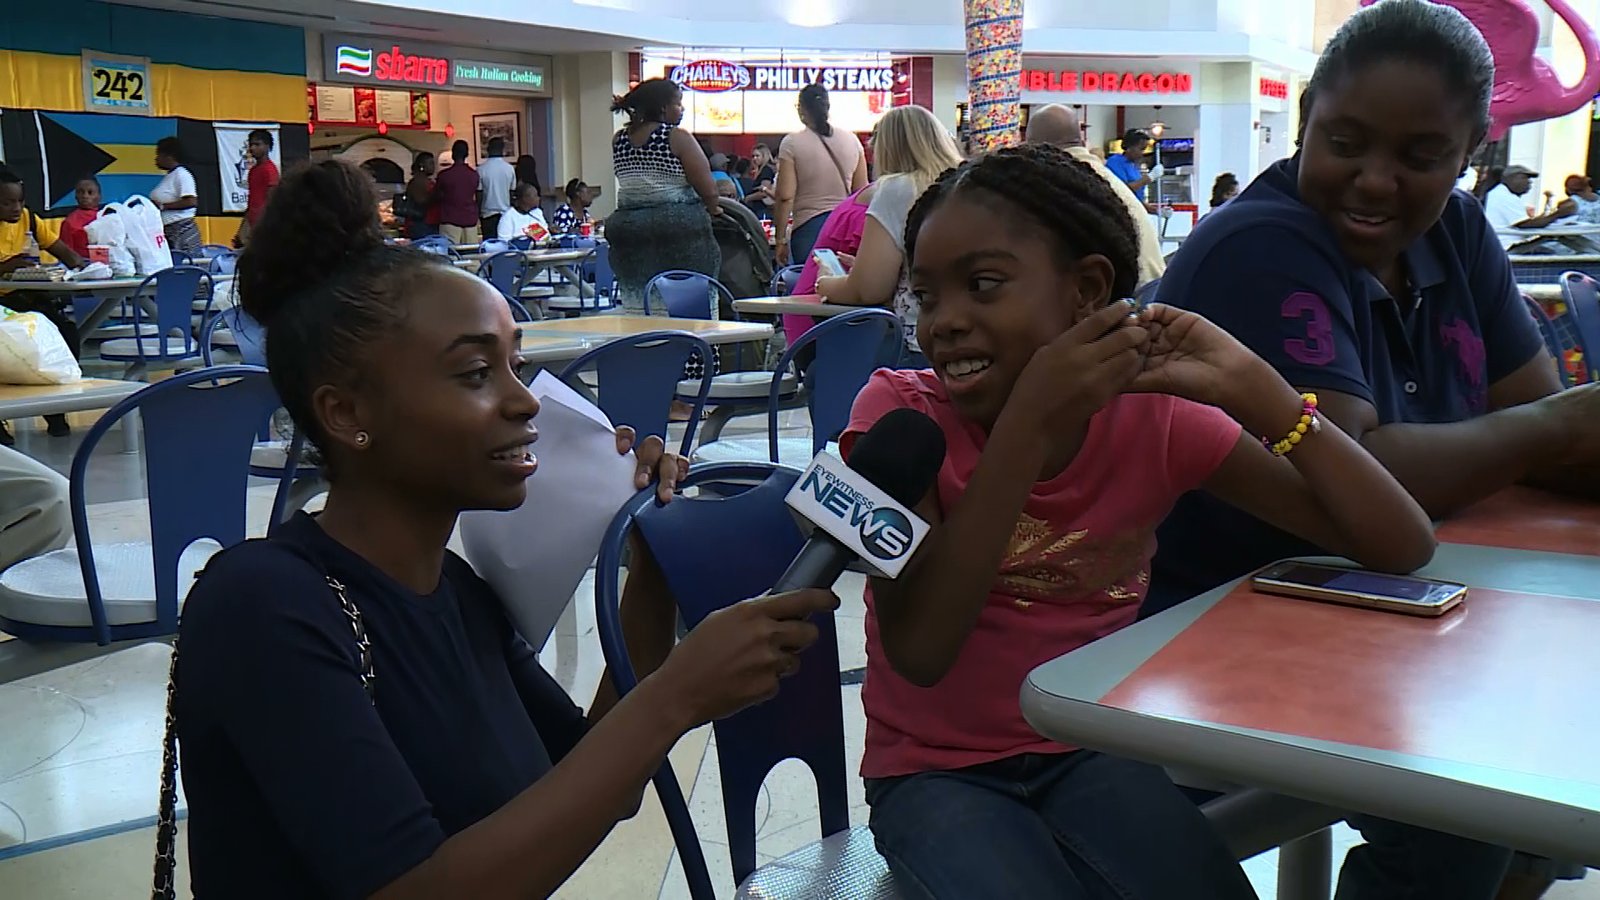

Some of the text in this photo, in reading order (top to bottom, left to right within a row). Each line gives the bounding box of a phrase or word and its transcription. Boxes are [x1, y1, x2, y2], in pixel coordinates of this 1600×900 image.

[374, 44, 449, 86] sbarro
[455, 65, 479, 79] Fresh
[510, 70, 542, 86] Cooking
[671, 65, 750, 87] CHARLEYS
[755, 68, 894, 90] PHILLY STEAKS
[93, 69, 143, 101] 242
[1082, 71, 1192, 95] DRAGON
[1281, 291, 1335, 366] 3
[813, 464, 875, 510] EYEWITNESS
[800, 471, 910, 556] NEWS
